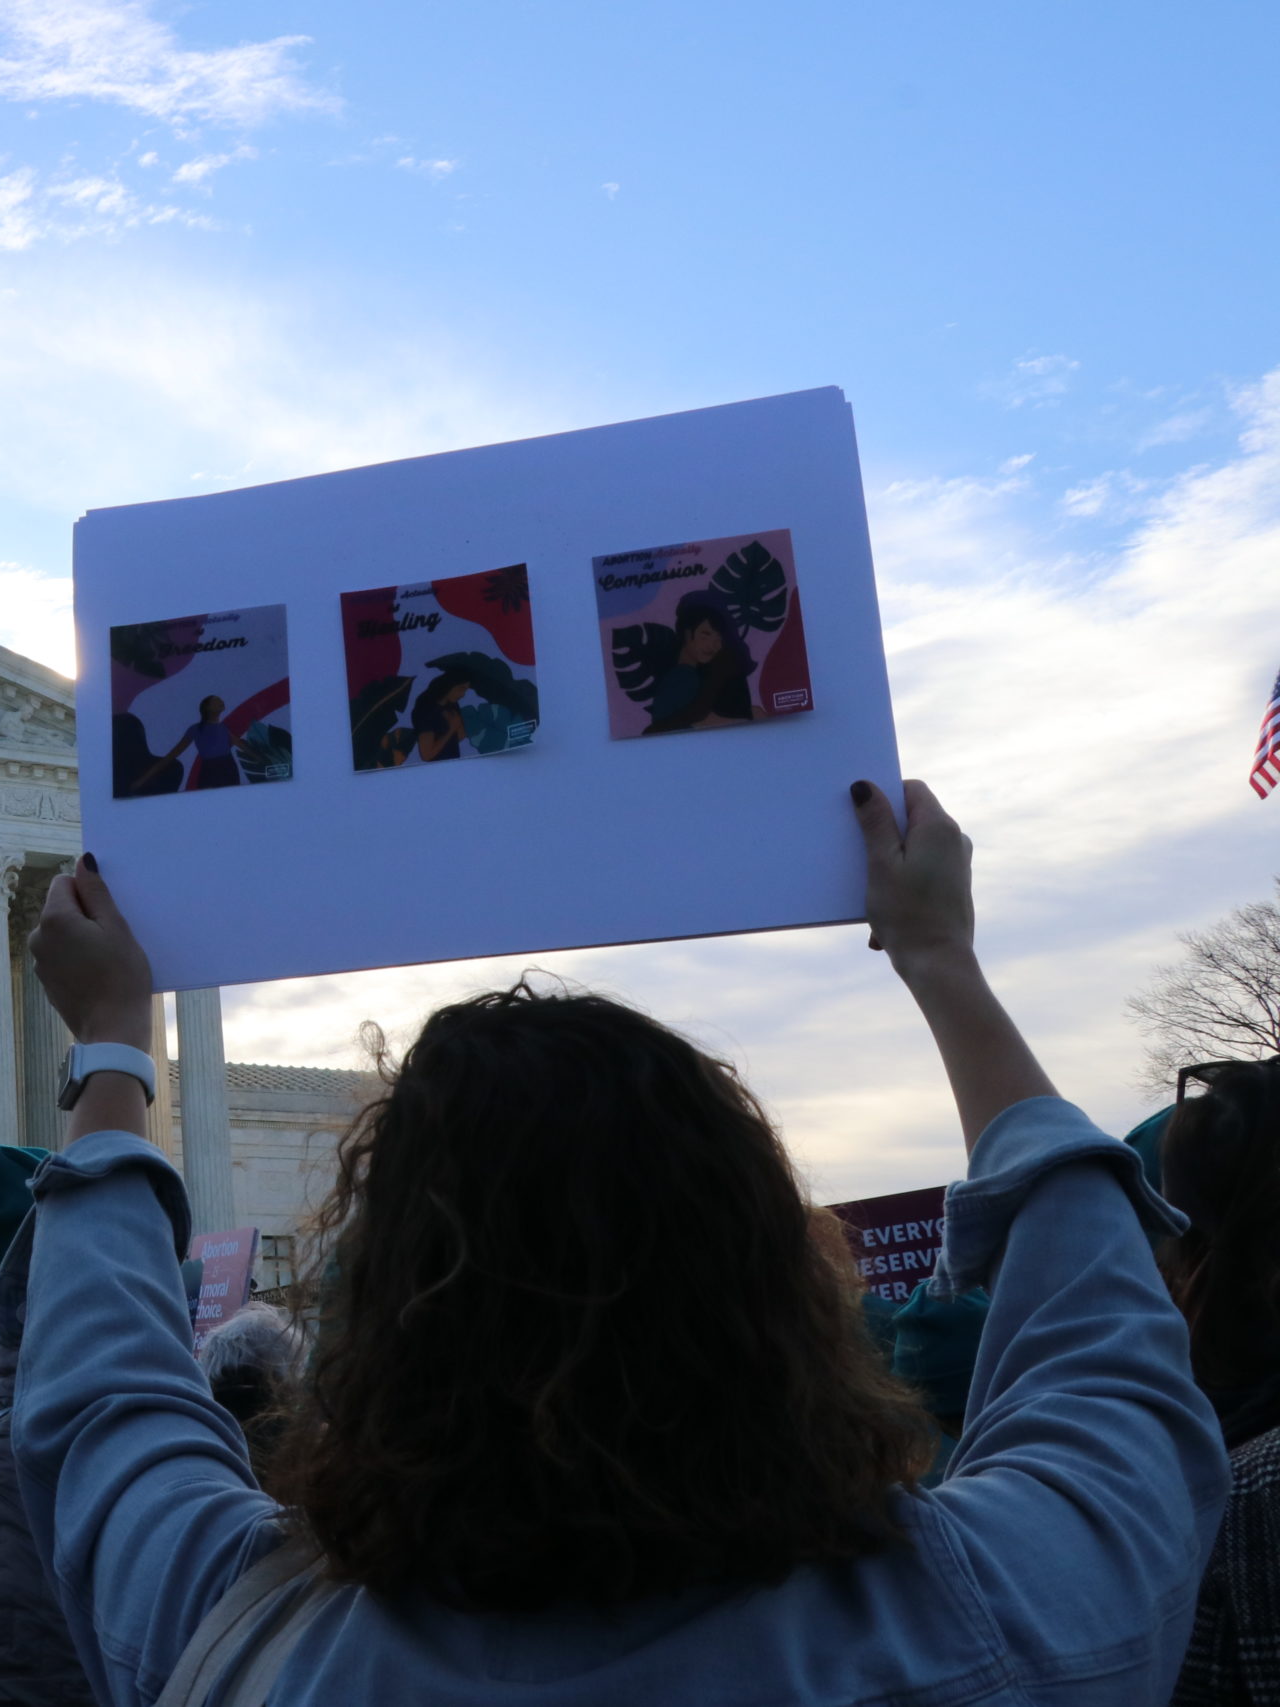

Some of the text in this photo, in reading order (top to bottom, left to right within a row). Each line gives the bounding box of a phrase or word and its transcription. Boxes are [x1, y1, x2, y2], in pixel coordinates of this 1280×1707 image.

[598, 560, 708, 592] Compassion
[862, 1217, 945, 1248] EVERYO
[202, 1239, 239, 1260] Abortion
[857, 1247, 942, 1276] ESERV
[203, 1277, 230, 1298] moral
[870, 1281, 910, 1301] ER
